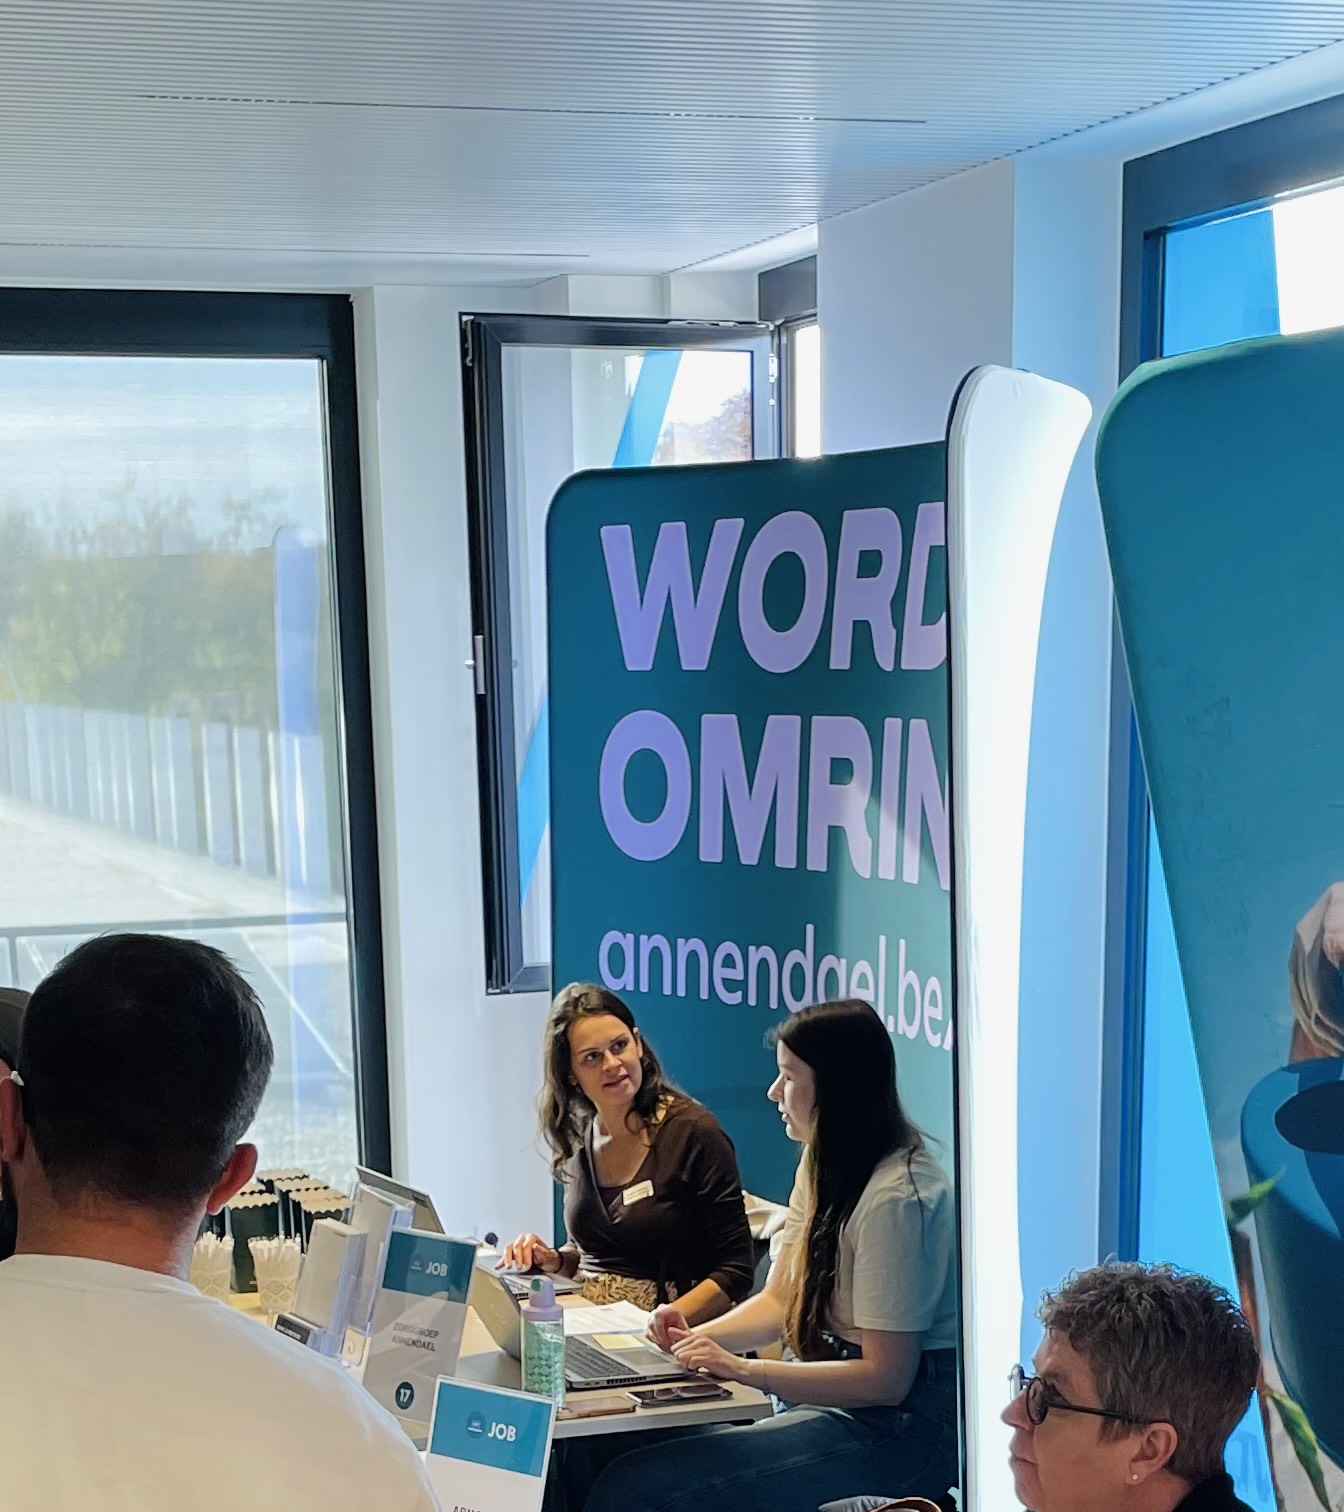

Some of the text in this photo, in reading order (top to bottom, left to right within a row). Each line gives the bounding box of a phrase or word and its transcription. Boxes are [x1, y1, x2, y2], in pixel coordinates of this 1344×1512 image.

[425, 1261, 448, 1277] JOB
[399, 1388, 412, 1403] 17
[487, 1422, 517, 1442] JOB
